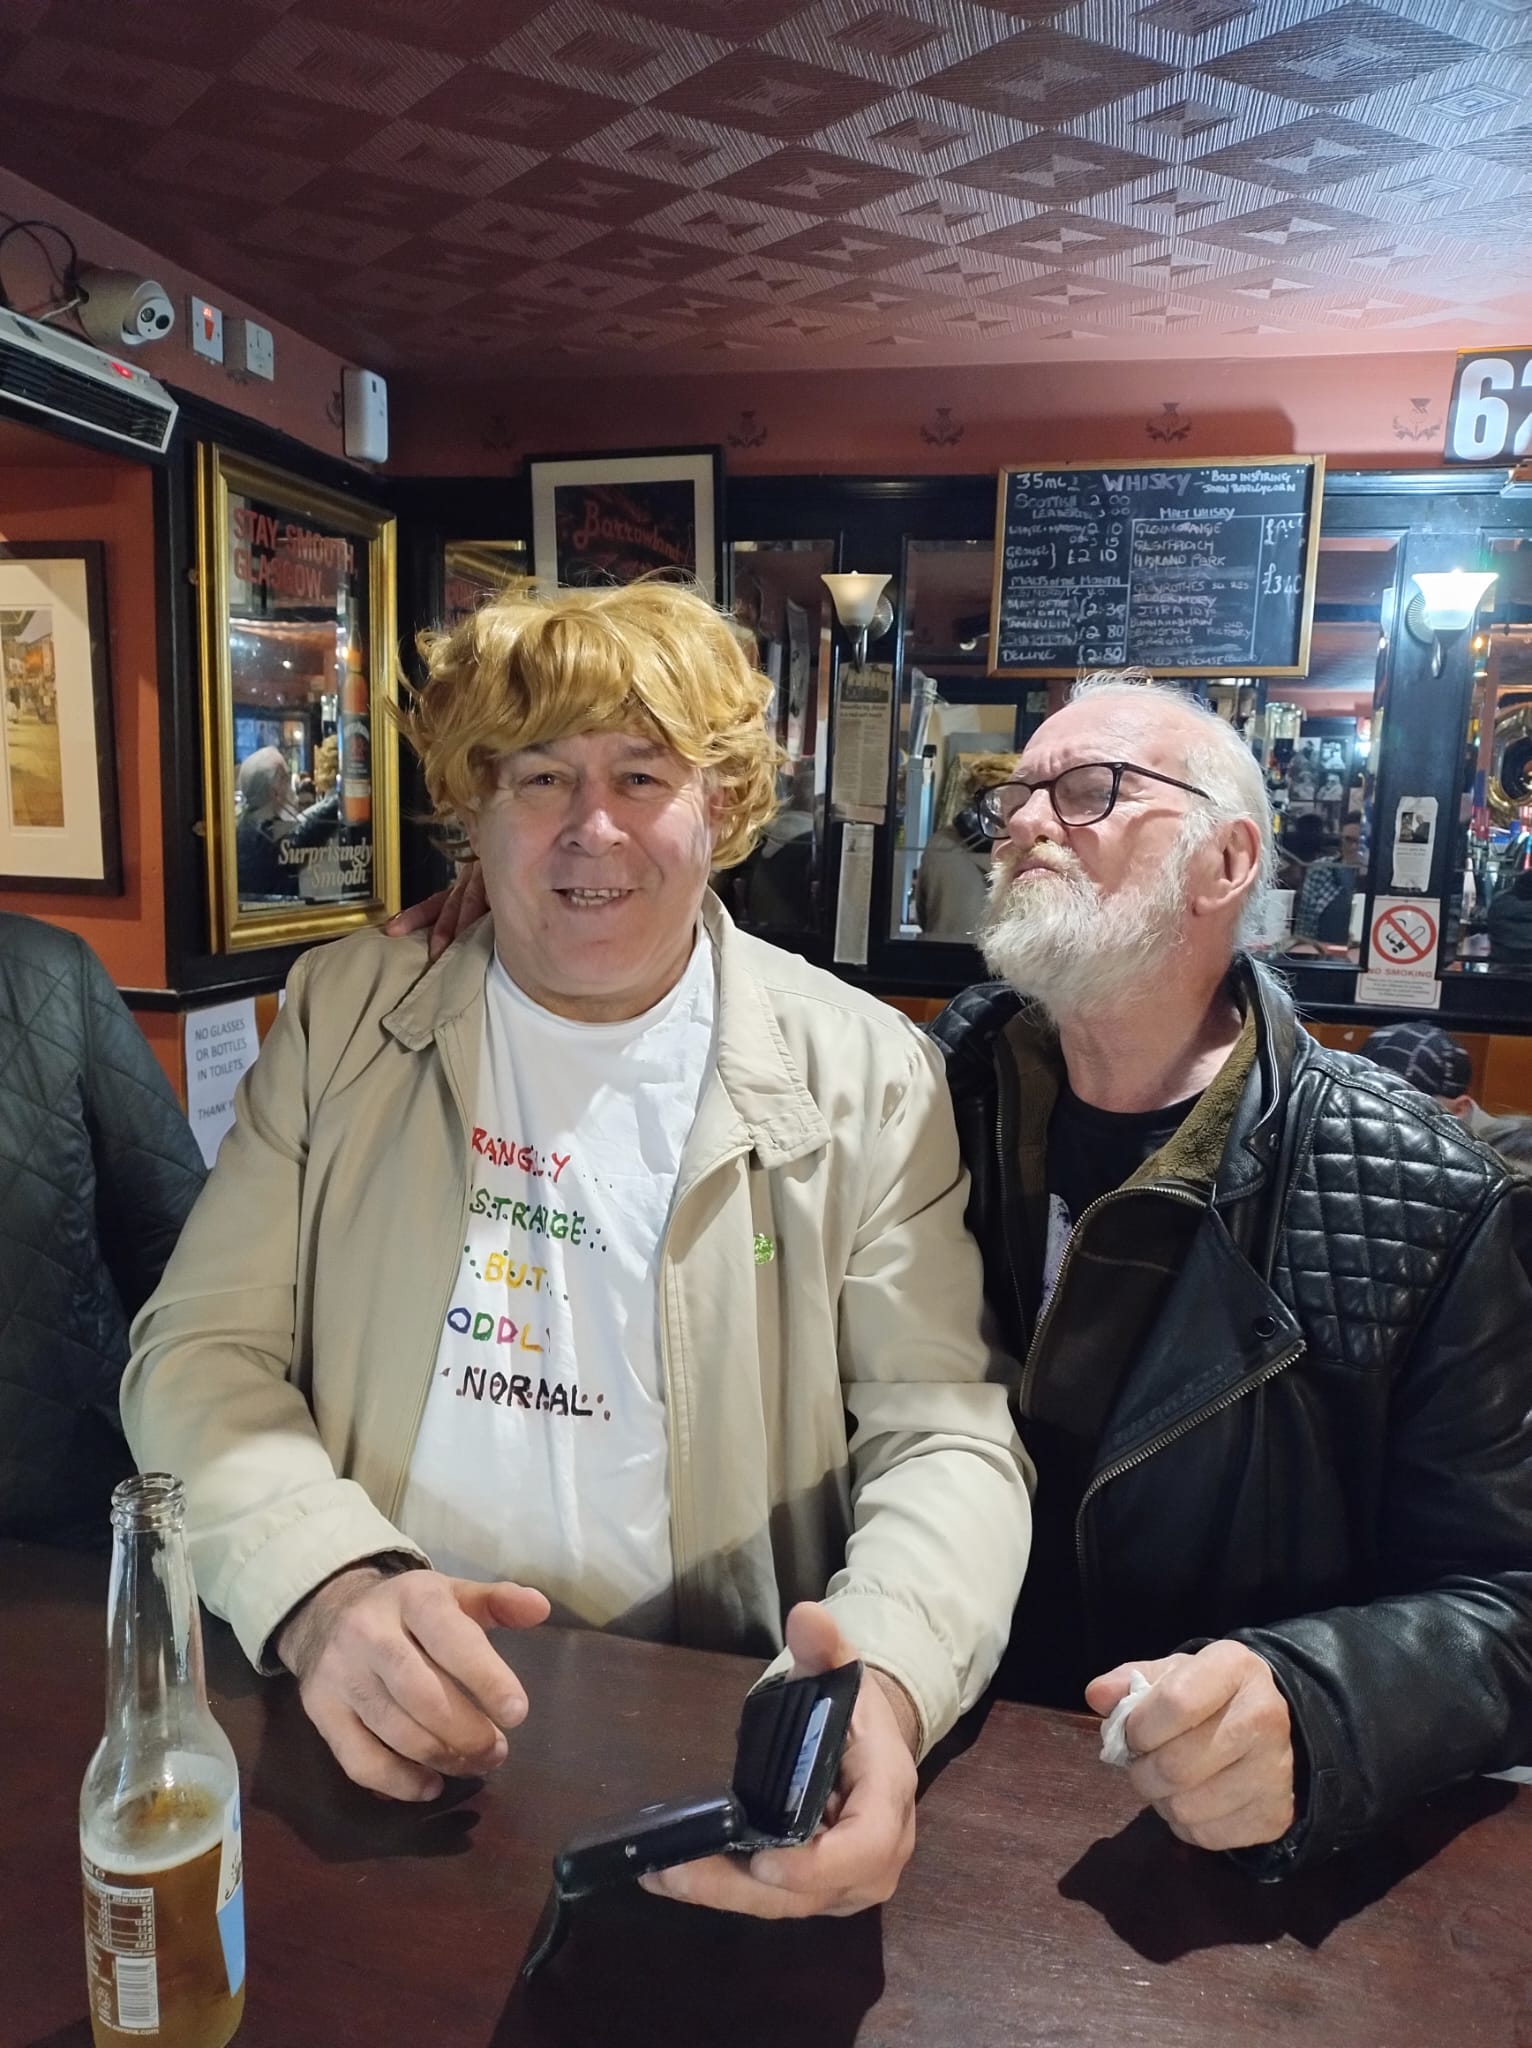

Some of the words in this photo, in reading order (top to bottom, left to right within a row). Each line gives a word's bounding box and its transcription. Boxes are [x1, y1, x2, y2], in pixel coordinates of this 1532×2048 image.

[1102, 473, 1192, 497] WHISKY
[1160, 507, 1190, 519] MALT
[1193, 507, 1235, 522] WHISKY
[234, 508, 277, 548] STAY
[1100, 549, 1118, 562] 10
[1192, 553, 1226, 568] PARK
[278, 836, 372, 869] Surprisingly
[312, 860, 367, 889] Smooth
[1384, 968, 1433, 978] SMOKING
[195, 1028, 209, 1041] NO
[210, 1018, 246, 1039] GLASSES
[196, 1048, 209, 1062] OR
[211, 1037, 248, 1059] BOTTLES
[197, 1068, 208, 1081] IN
[197, 1102, 227, 1121] THANK
[484, 1252, 548, 1292] BUT
[447, 1307, 552, 1353] ODDL
